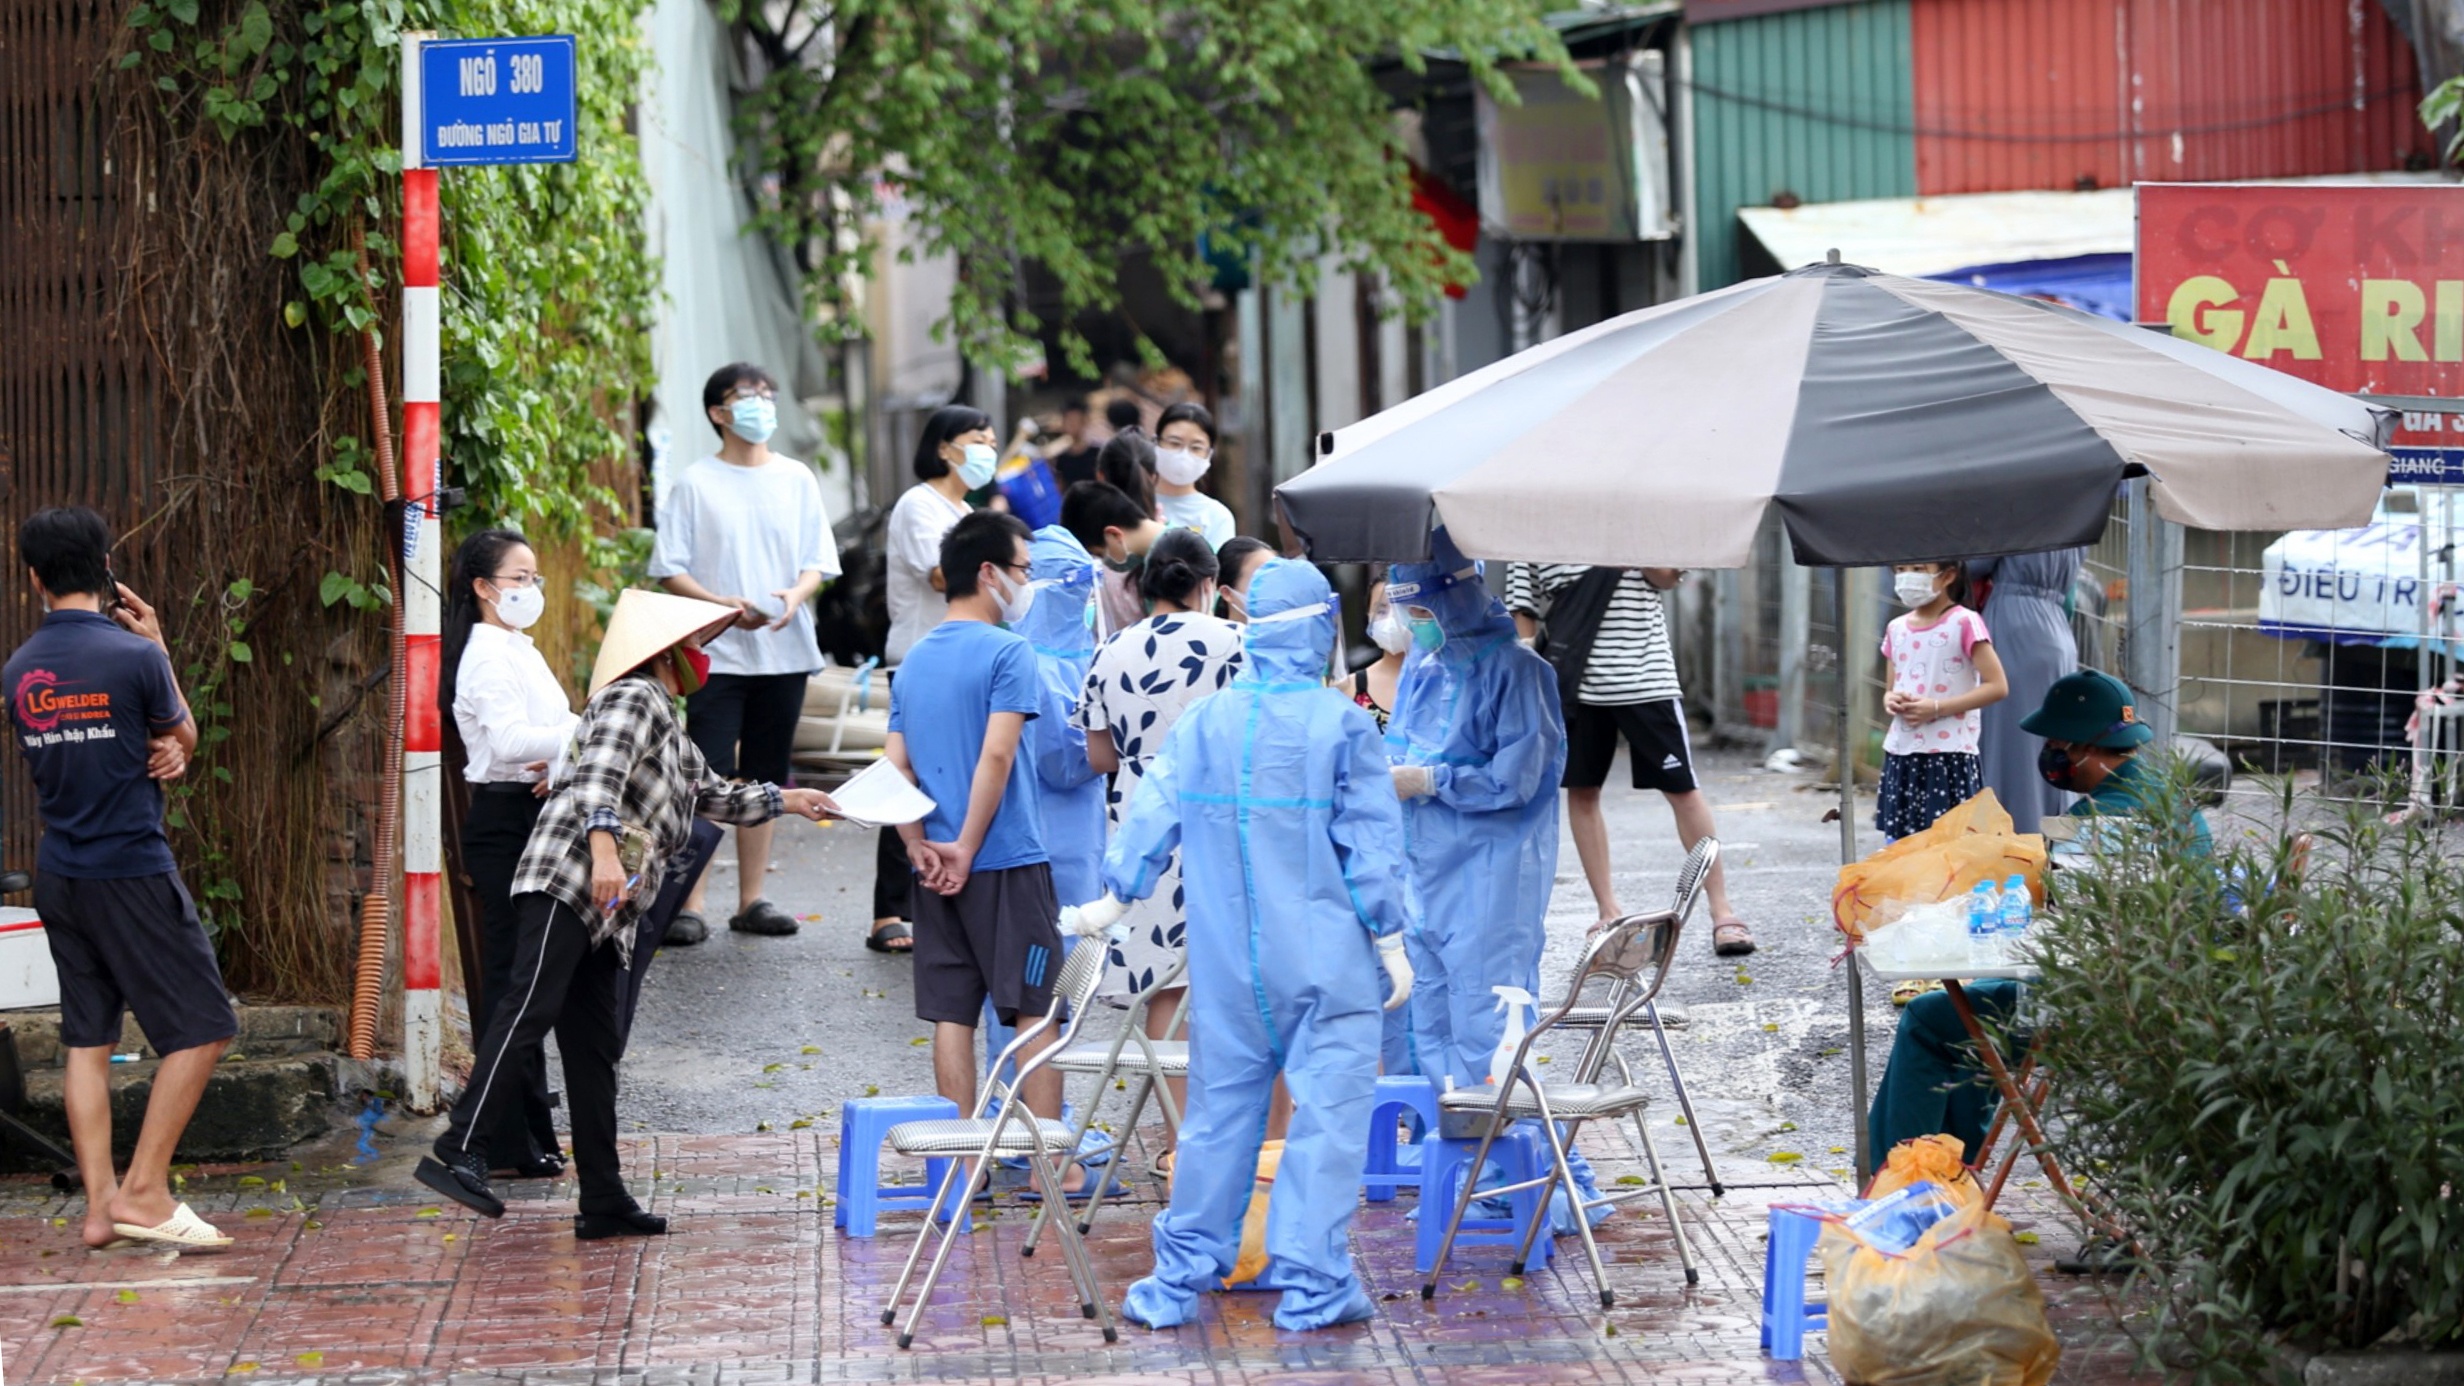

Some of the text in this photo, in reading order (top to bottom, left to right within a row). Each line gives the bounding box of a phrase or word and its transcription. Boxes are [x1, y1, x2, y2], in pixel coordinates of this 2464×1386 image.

[459, 49, 543, 97] NGÕ 380
[437, 117, 563, 150] ĐƯỜNG NGÔ GIA TỰ
[2166, 259, 2323, 361] GÀ
[2374, 574, 2420, 606] TR
